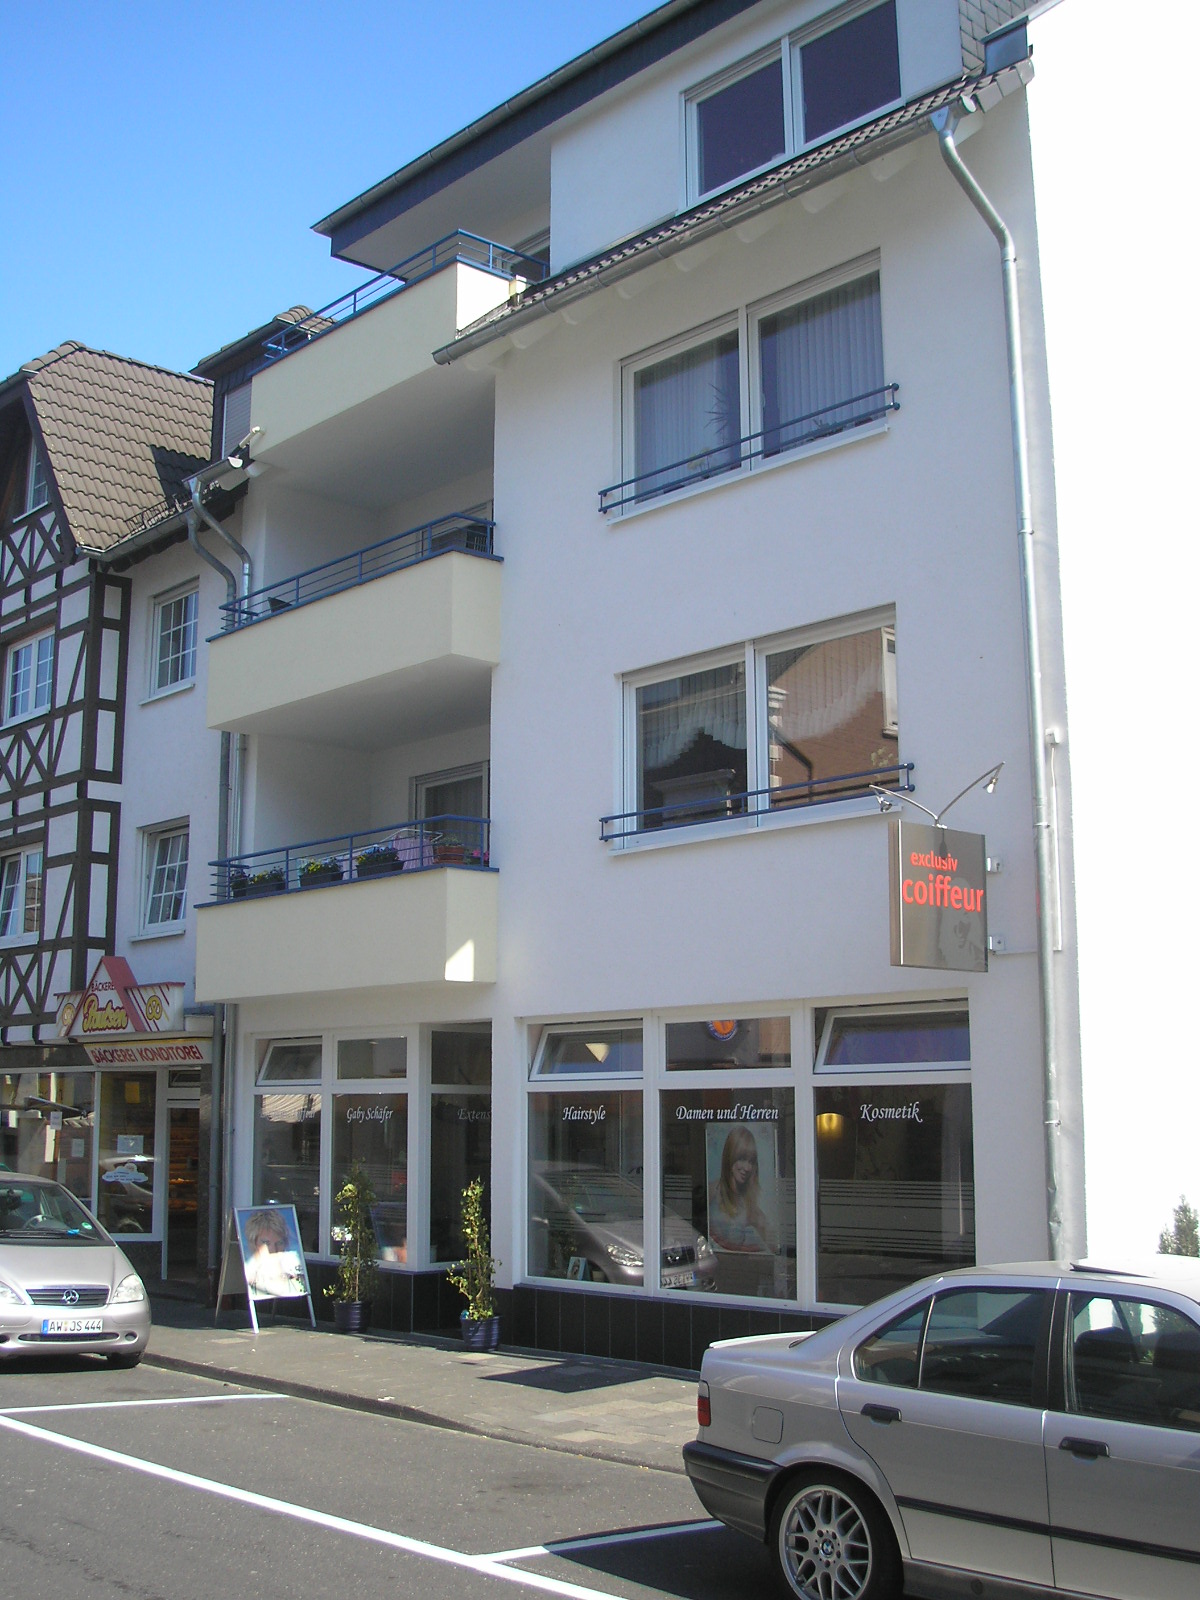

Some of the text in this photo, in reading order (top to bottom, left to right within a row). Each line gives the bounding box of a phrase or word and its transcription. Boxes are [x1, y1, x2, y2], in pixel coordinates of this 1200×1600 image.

[910, 850, 958, 872] exclusiv
[902, 873, 984, 913] coiffeur
[91, 980, 115, 992] BÄCKERE
[91, 1044, 204, 1063] BÄCKEREI KONDITOREI
[347, 1106, 394, 1123] Gaby Schäfer
[457, 1108, 491, 1122] Extens
[562, 1105, 606, 1125] Hairstyle
[676, 1103, 779, 1120] Damen und Herren
[860, 1101, 924, 1123] Kosmetik
[49, 1321, 63, 1332] AW
[84, 1320, 102, 1331] 444
